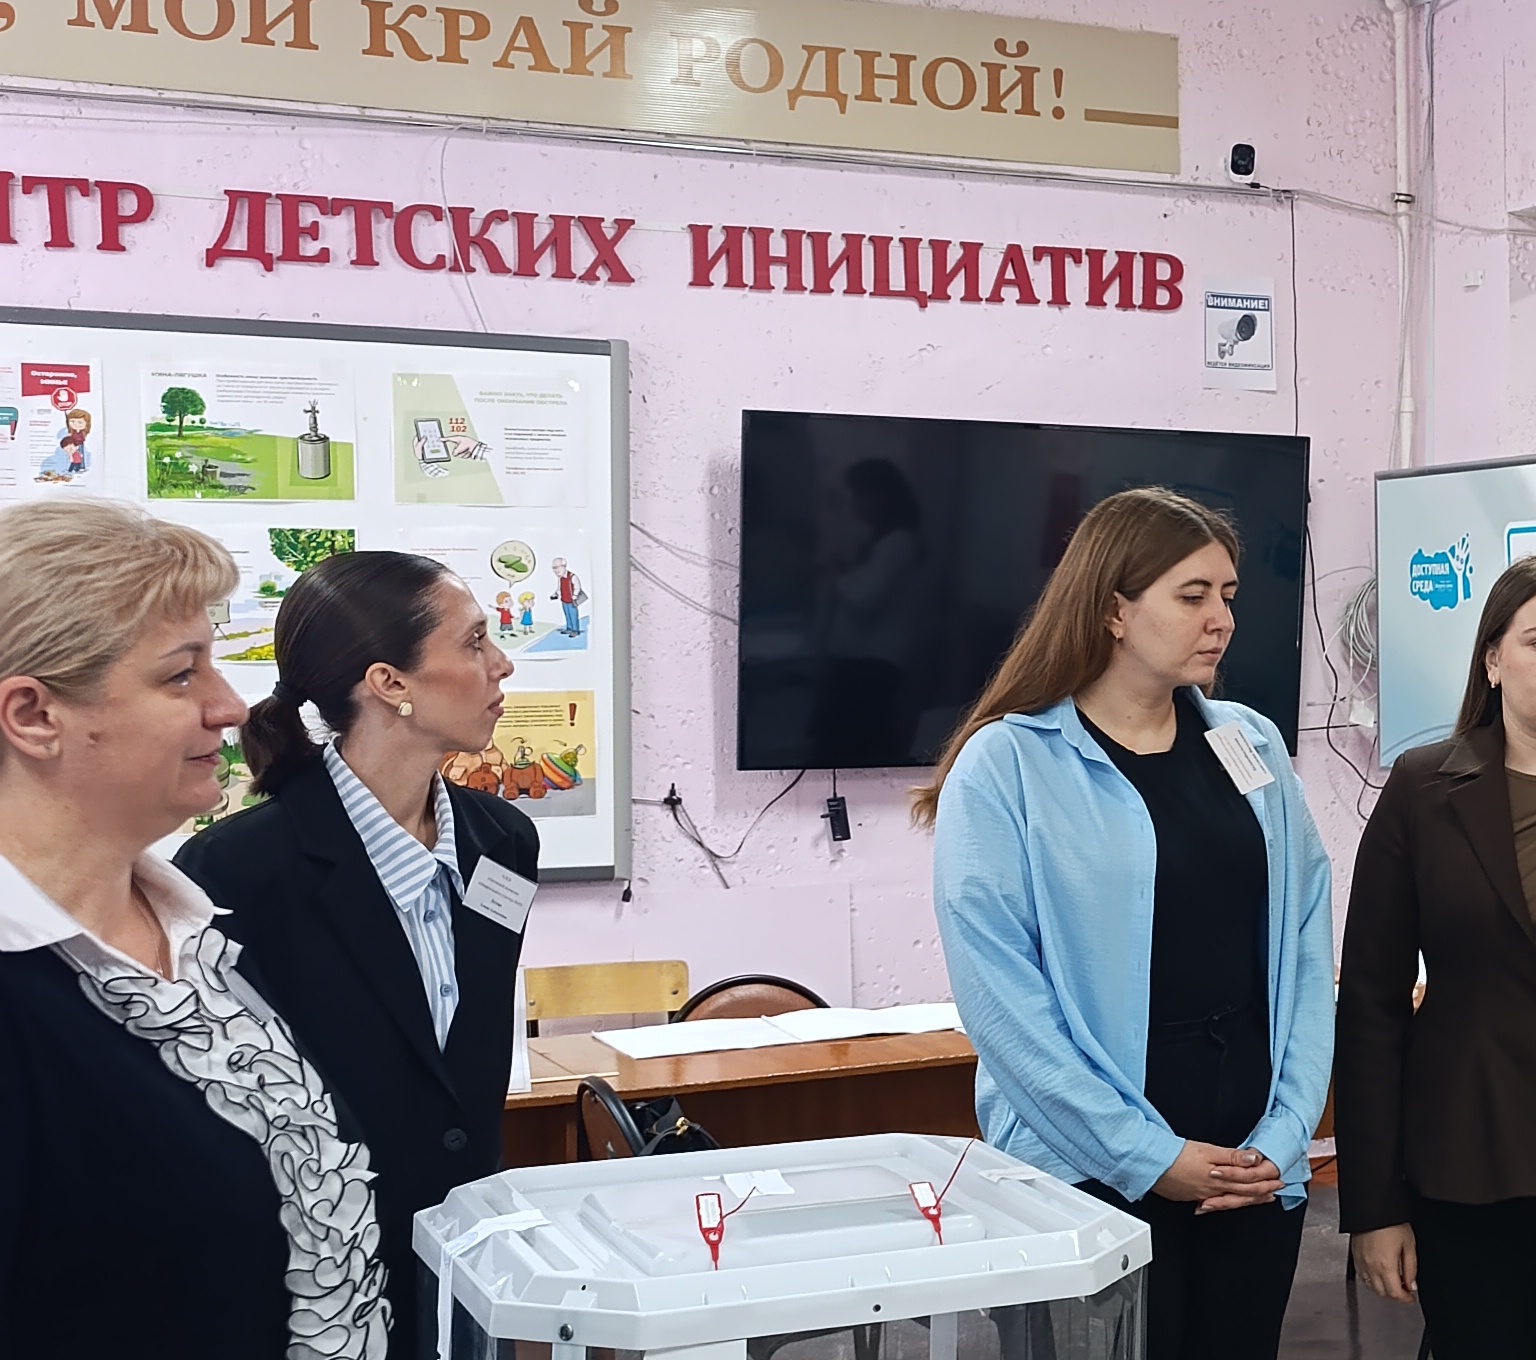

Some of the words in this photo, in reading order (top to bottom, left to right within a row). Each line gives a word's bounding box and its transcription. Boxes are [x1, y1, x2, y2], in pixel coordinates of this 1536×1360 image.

[669, 30, 1065, 121] РОДНОЙ!
[204, 188, 636, 285] ДЕТСКИХ
[688, 223, 1185, 312] ИНИЦИАТИВ
[1207, 296, 1269, 310] ВНИМАНИЕ!
[448, 417, 465, 425] 112
[450, 425, 467, 433] 102
